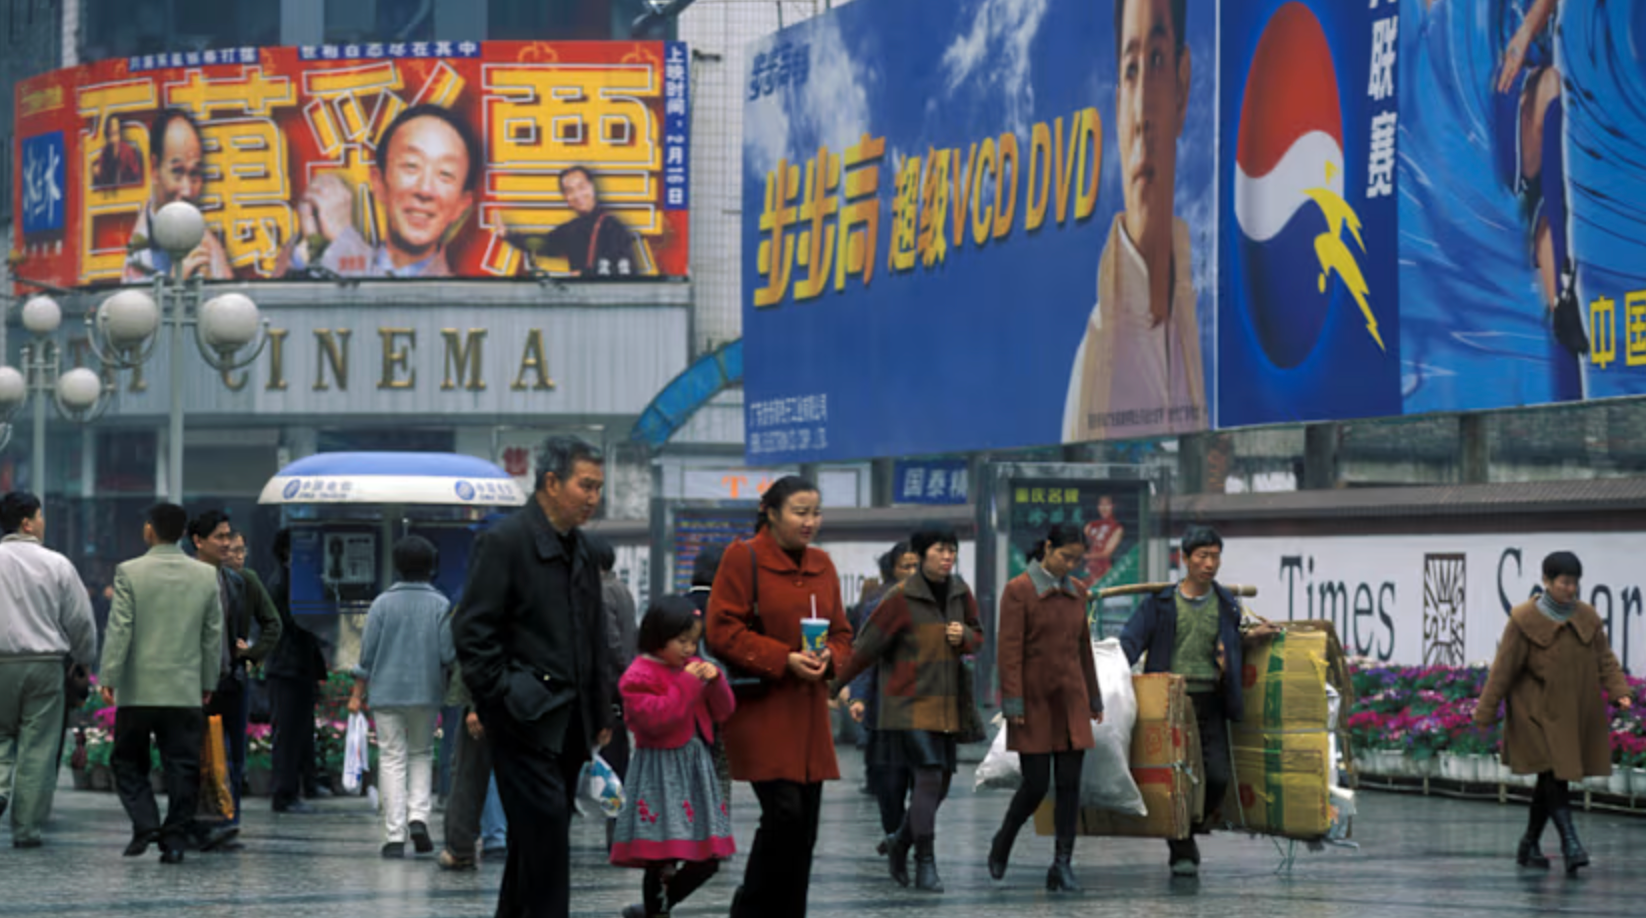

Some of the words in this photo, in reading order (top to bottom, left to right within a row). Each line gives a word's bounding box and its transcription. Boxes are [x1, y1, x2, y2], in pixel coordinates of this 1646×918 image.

[1367, 0, 1398, 198] 联赛
[754, 133, 886, 307] 步步高
[1025, 107, 1102, 230] DVD
[1279, 554, 1396, 661] Times
[1497, 546, 1643, 674] Sar
